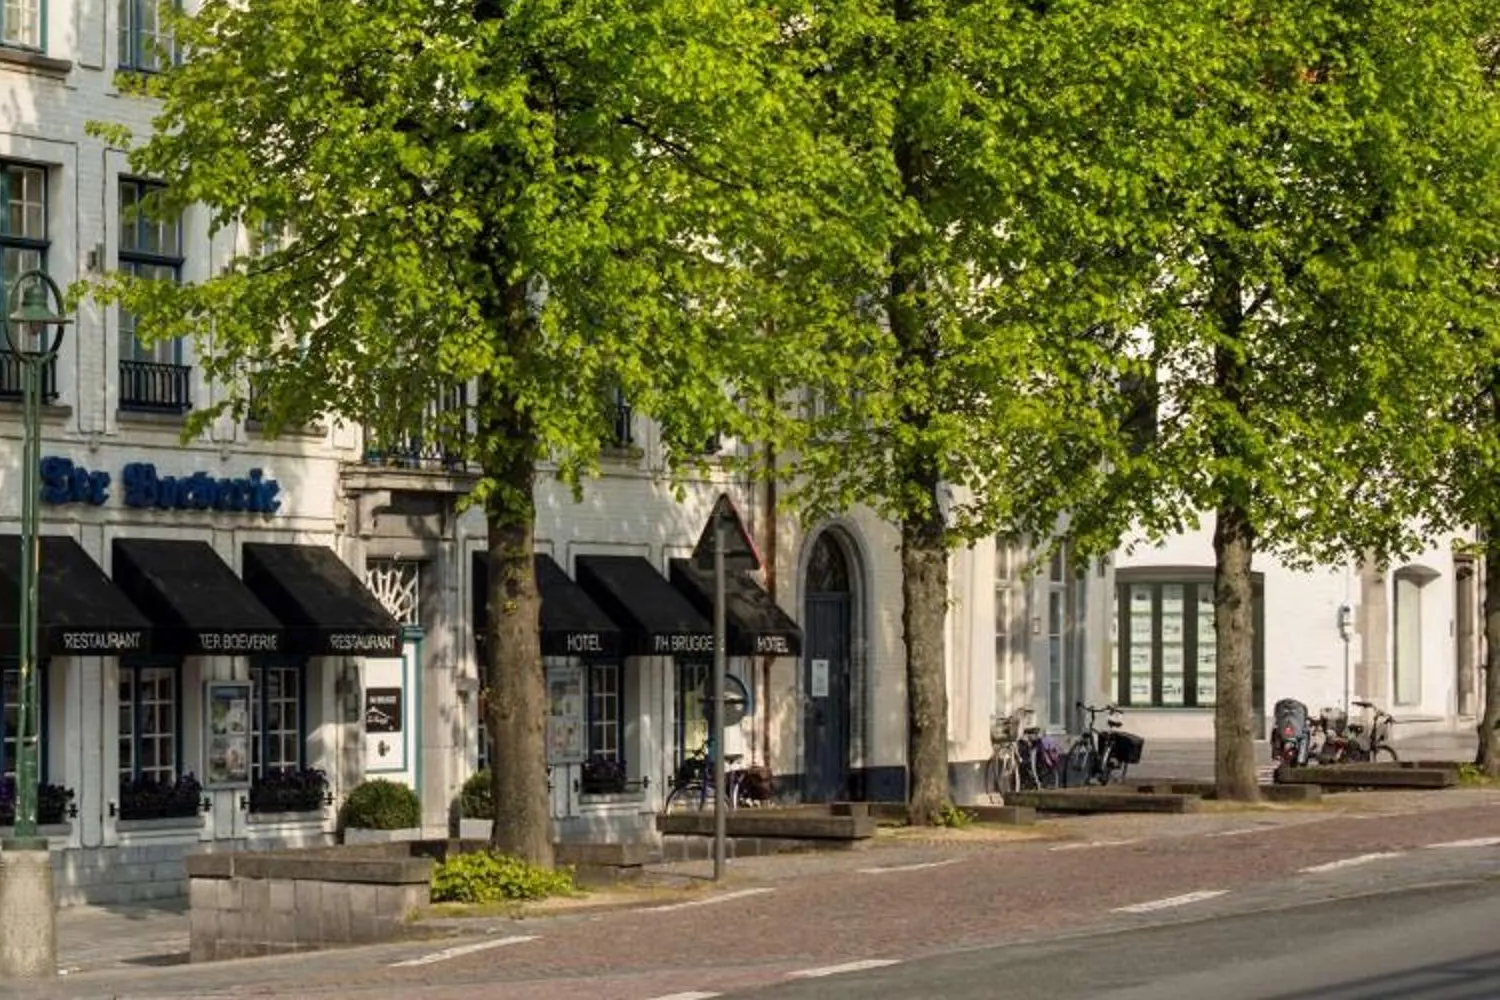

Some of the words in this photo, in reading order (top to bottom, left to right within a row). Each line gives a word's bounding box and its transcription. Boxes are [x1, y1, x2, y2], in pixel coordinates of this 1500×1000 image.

[62, 631, 141, 650] RESTAURANT
[199, 632, 221, 649] TER
[223, 632, 278, 650] BOEVERIE
[330, 633, 397, 650] RESTAURANT
[566, 633, 603, 651] HOTEL
[671, 634, 714, 652] BRUGGE
[756, 635, 789, 653] HOTEL
